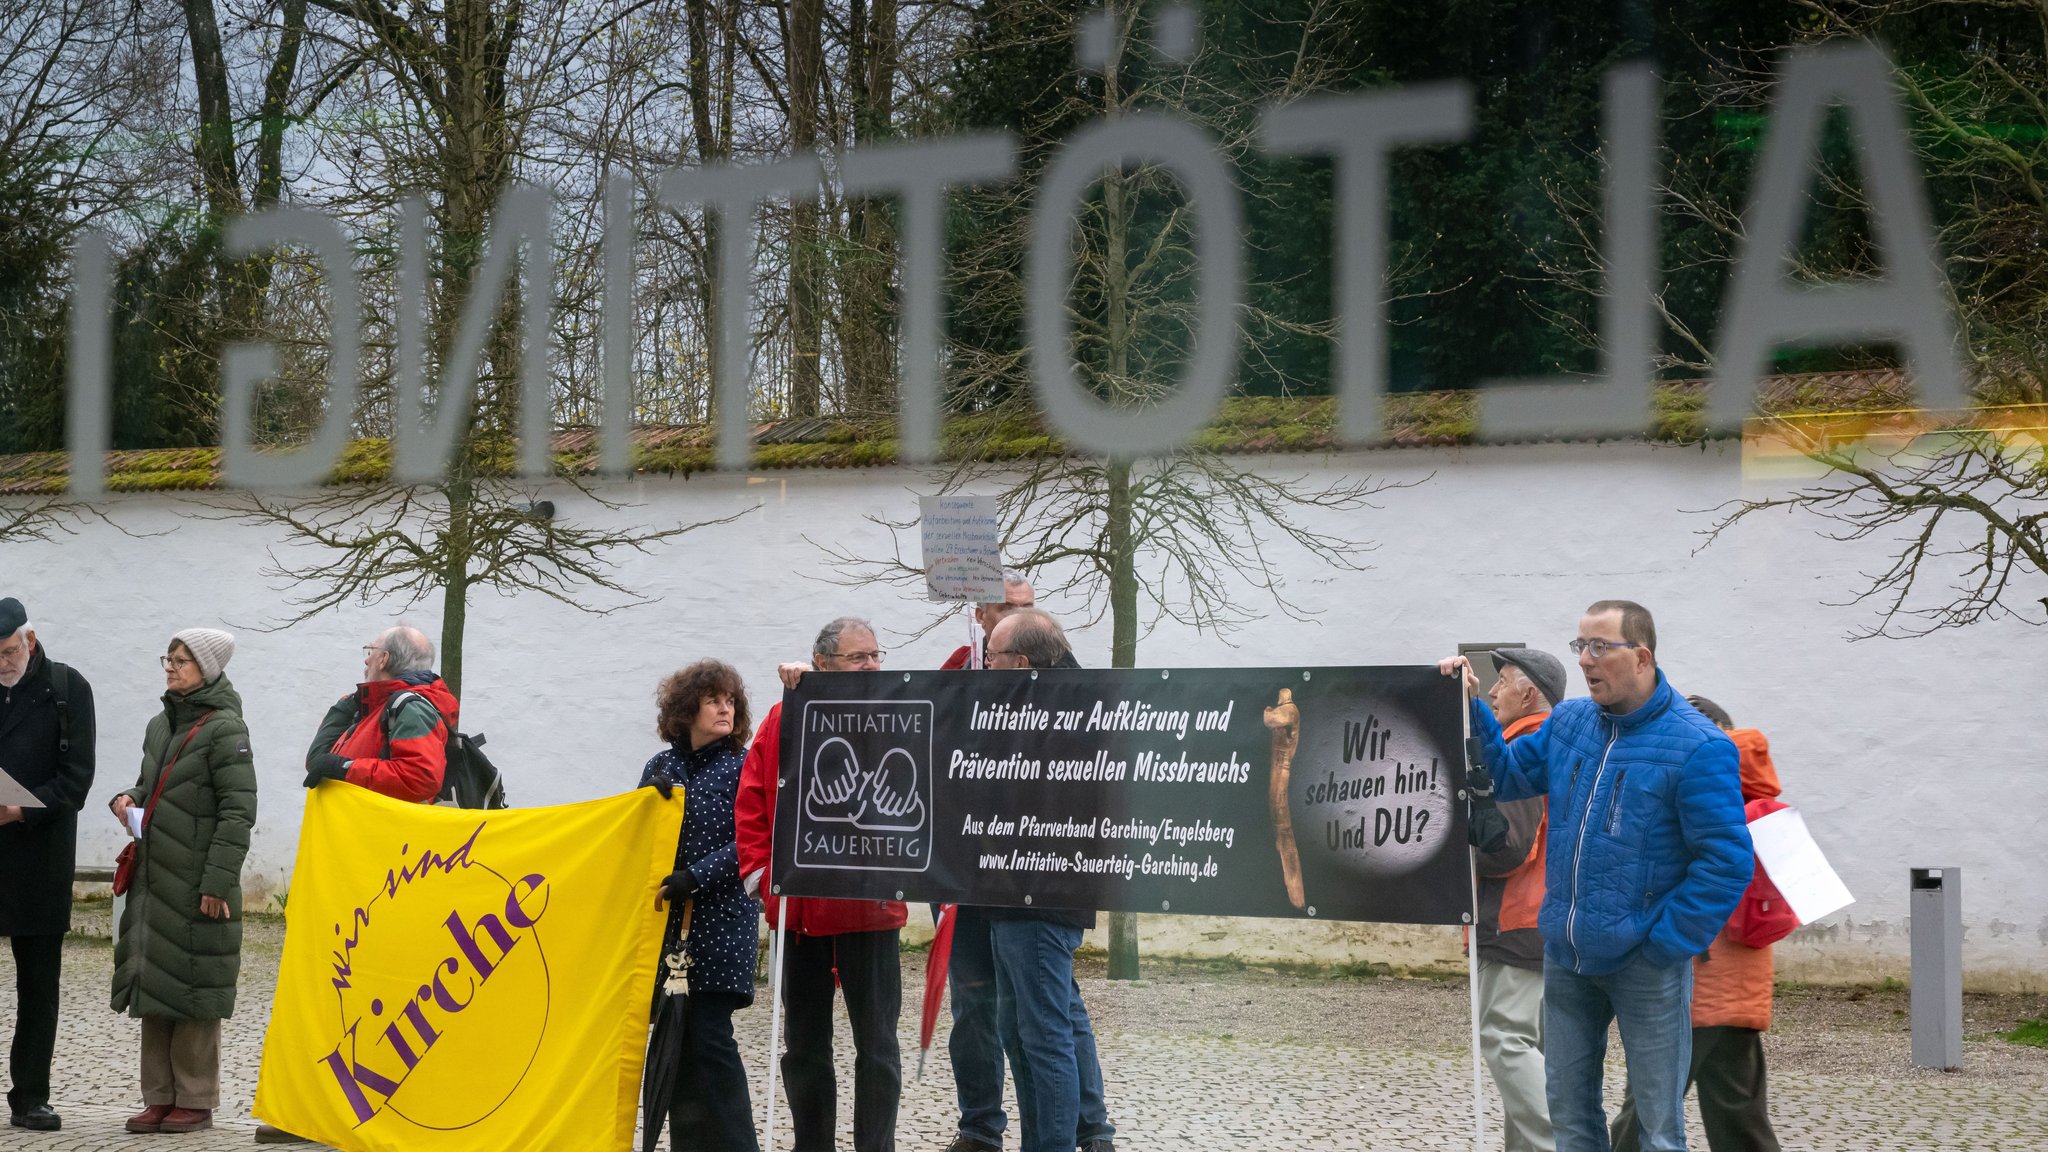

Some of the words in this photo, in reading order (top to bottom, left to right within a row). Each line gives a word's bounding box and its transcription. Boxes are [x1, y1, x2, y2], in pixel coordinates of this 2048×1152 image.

[812, 710, 922, 733] INITIATIVE
[971, 700, 1050, 731] Initiative
[1054, 711, 1084, 731] zur
[1085, 700, 1191, 741] Aufklärung
[1195, 700, 1234, 732] und
[1343, 714, 1391, 763] Wir
[948, 748, 1041, 781] Prävention
[1046, 749, 1127, 782] sexuellen
[1133, 750, 1251, 784] Missbrauchs
[1305, 771, 1385, 806] schauen
[1394, 757, 1438, 795] hin!
[804, 830, 920, 858] SAUERTEIG
[962, 814, 984, 836] Aus
[988, 815, 1015, 836] dem
[1018, 816, 1097, 839] Pfarrverband
[1101, 817, 1235, 849] Garching/Engelsberg
[1326, 816, 1366, 851] Und
[1373, 805, 1430, 847] DU?
[979, 849, 1219, 883] www.Initiative-Sauerteig-Garching.de
[331, 907, 370, 989] wir
[384, 821, 487, 899] sind
[317, 873, 550, 1130] Kirche
